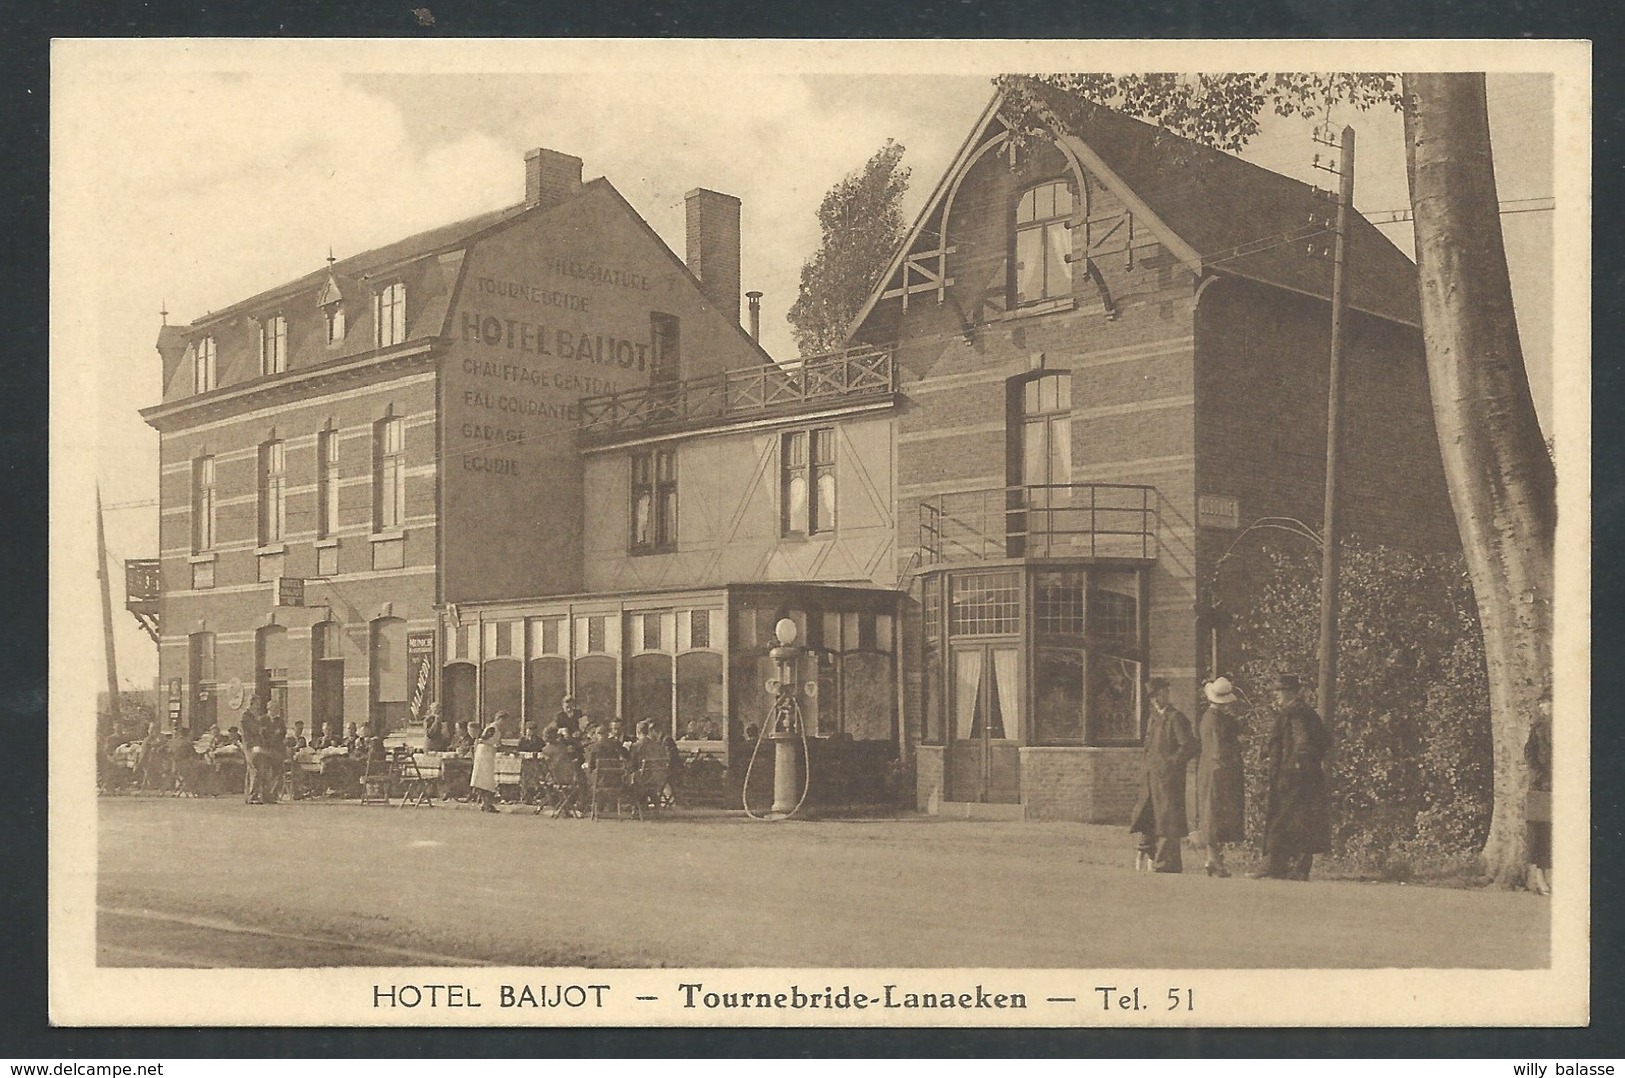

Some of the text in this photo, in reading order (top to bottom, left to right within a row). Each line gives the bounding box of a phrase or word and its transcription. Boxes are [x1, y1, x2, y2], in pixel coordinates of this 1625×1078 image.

[461, 312, 550, 356] HOTEL
[462, 359, 617, 396] CHAUFFAGE CENTRAL
[463, 391, 580, 422] EAU COURANTE
[461, 422, 526, 446] GARAGE
[463, 455, 519, 477] ECURIE
